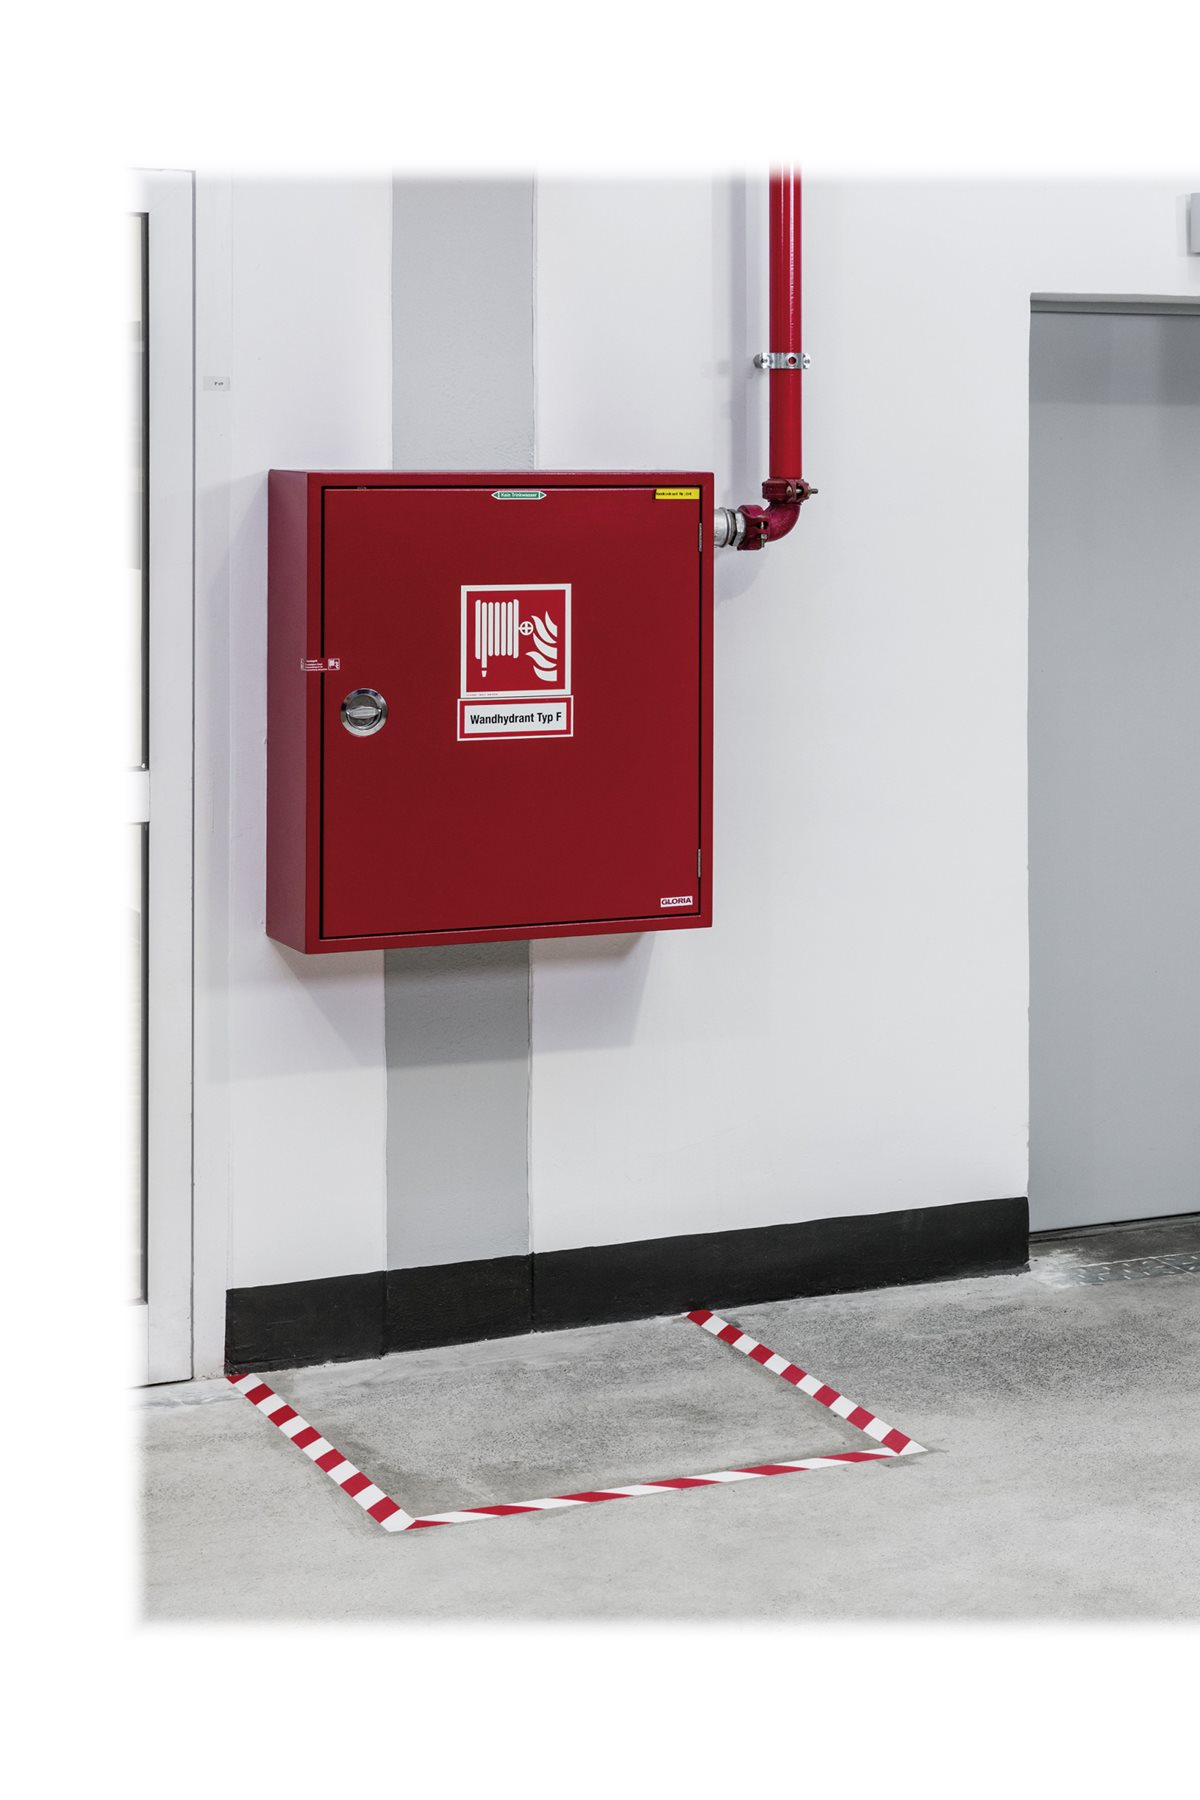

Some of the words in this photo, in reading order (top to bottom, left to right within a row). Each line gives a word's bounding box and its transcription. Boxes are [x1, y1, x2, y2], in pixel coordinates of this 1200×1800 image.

[470, 713, 534, 725] Wandhydrant
[537, 712, 553, 724] Typ
[556, 712, 562, 721] F
[661, 897, 692, 905] GLORIA
